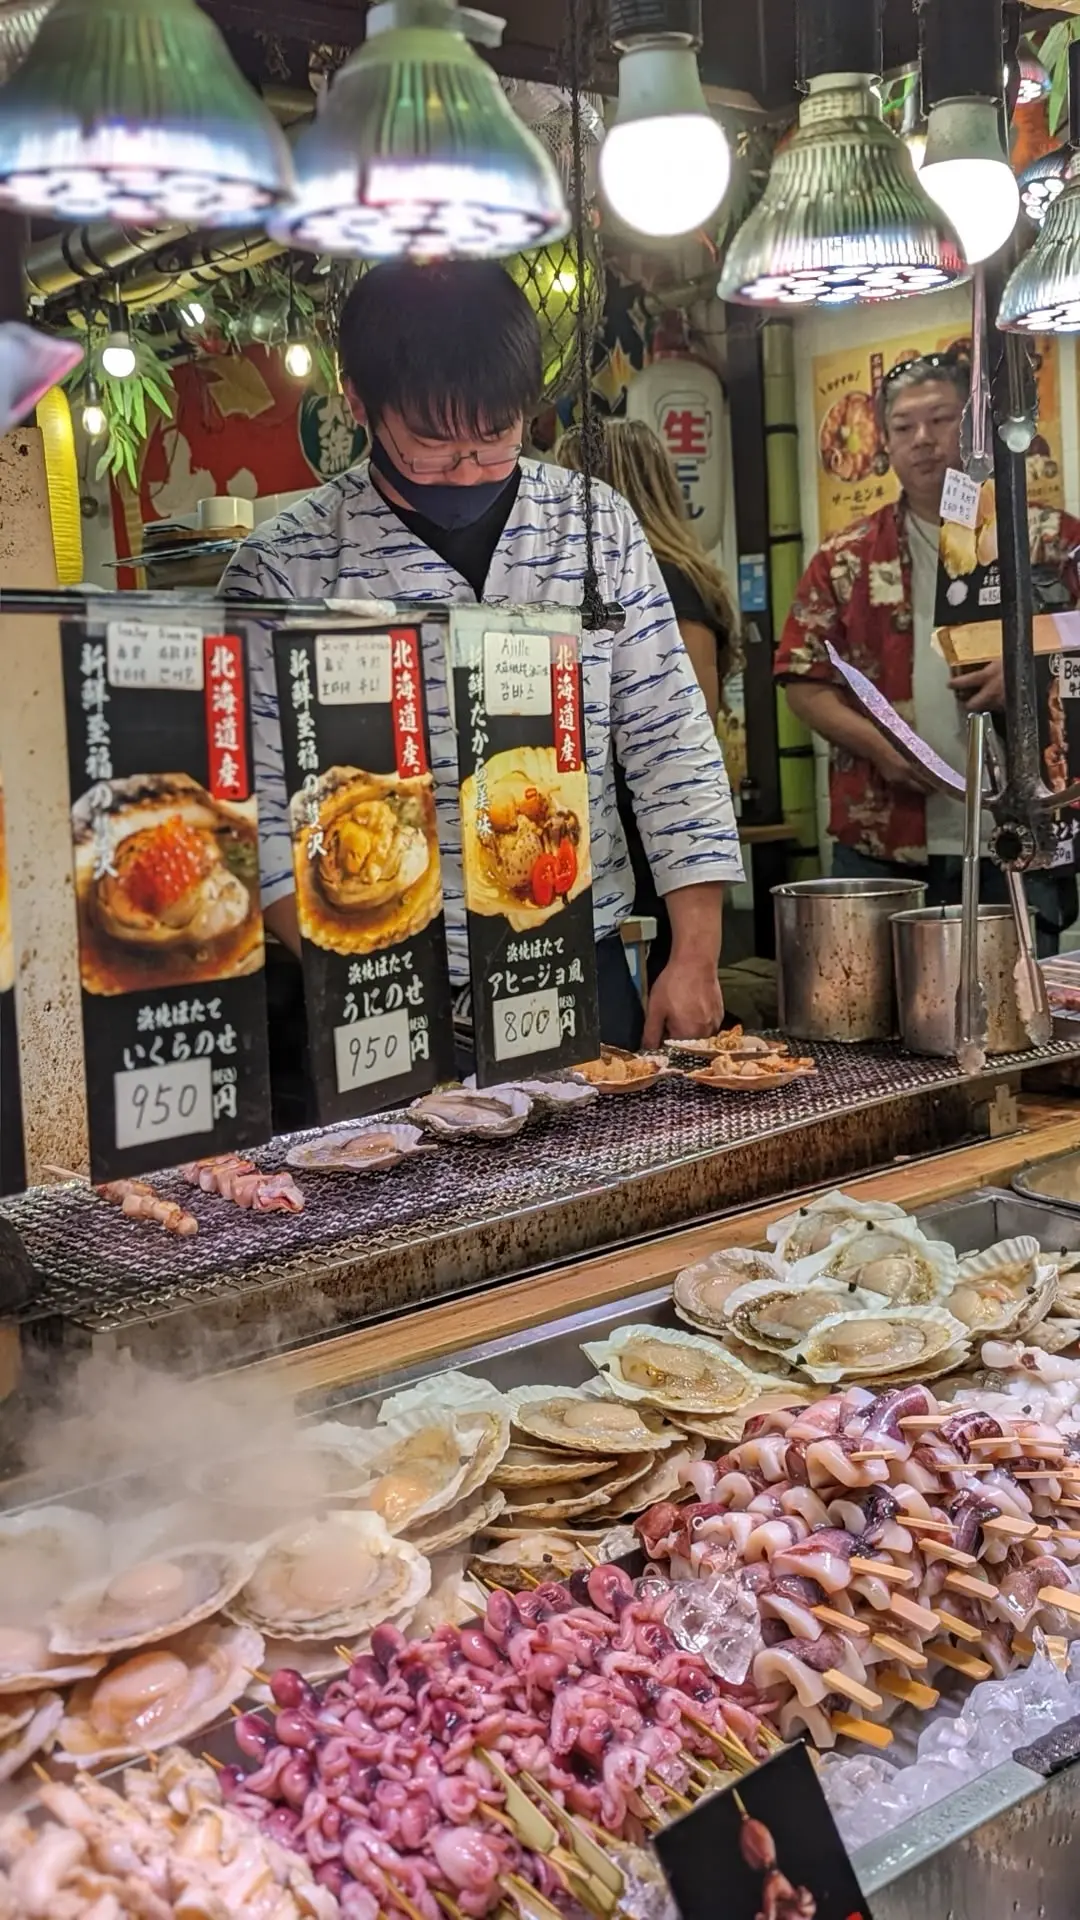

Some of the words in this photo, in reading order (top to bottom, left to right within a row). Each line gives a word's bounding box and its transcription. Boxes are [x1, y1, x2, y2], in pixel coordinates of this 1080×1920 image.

[392, 639, 421, 767] 北海道産
[501, 681, 534, 701] 감바스
[556, 645, 577, 762] 北海道産
[210, 645, 240, 788] 北海道産
[347, 950, 414, 985] 浜焼ほたて
[506, 937, 565, 963] 浜焼ほたて
[342, 974, 425, 1024] うにのせ
[487, 957, 585, 998] アヒージョ風
[136, 997, 222, 1031] 浜焼ほたて
[504, 1009, 550, 1042] 800
[559, 1008, 576, 1040] 円
[123, 1023, 237, 1069] いくらのせ
[349, 1035, 398, 1077] 950
[410, 1030, 430, 1062] 円
[131, 1084, 198, 1128] 950
[213, 1083, 238, 1120] 円
